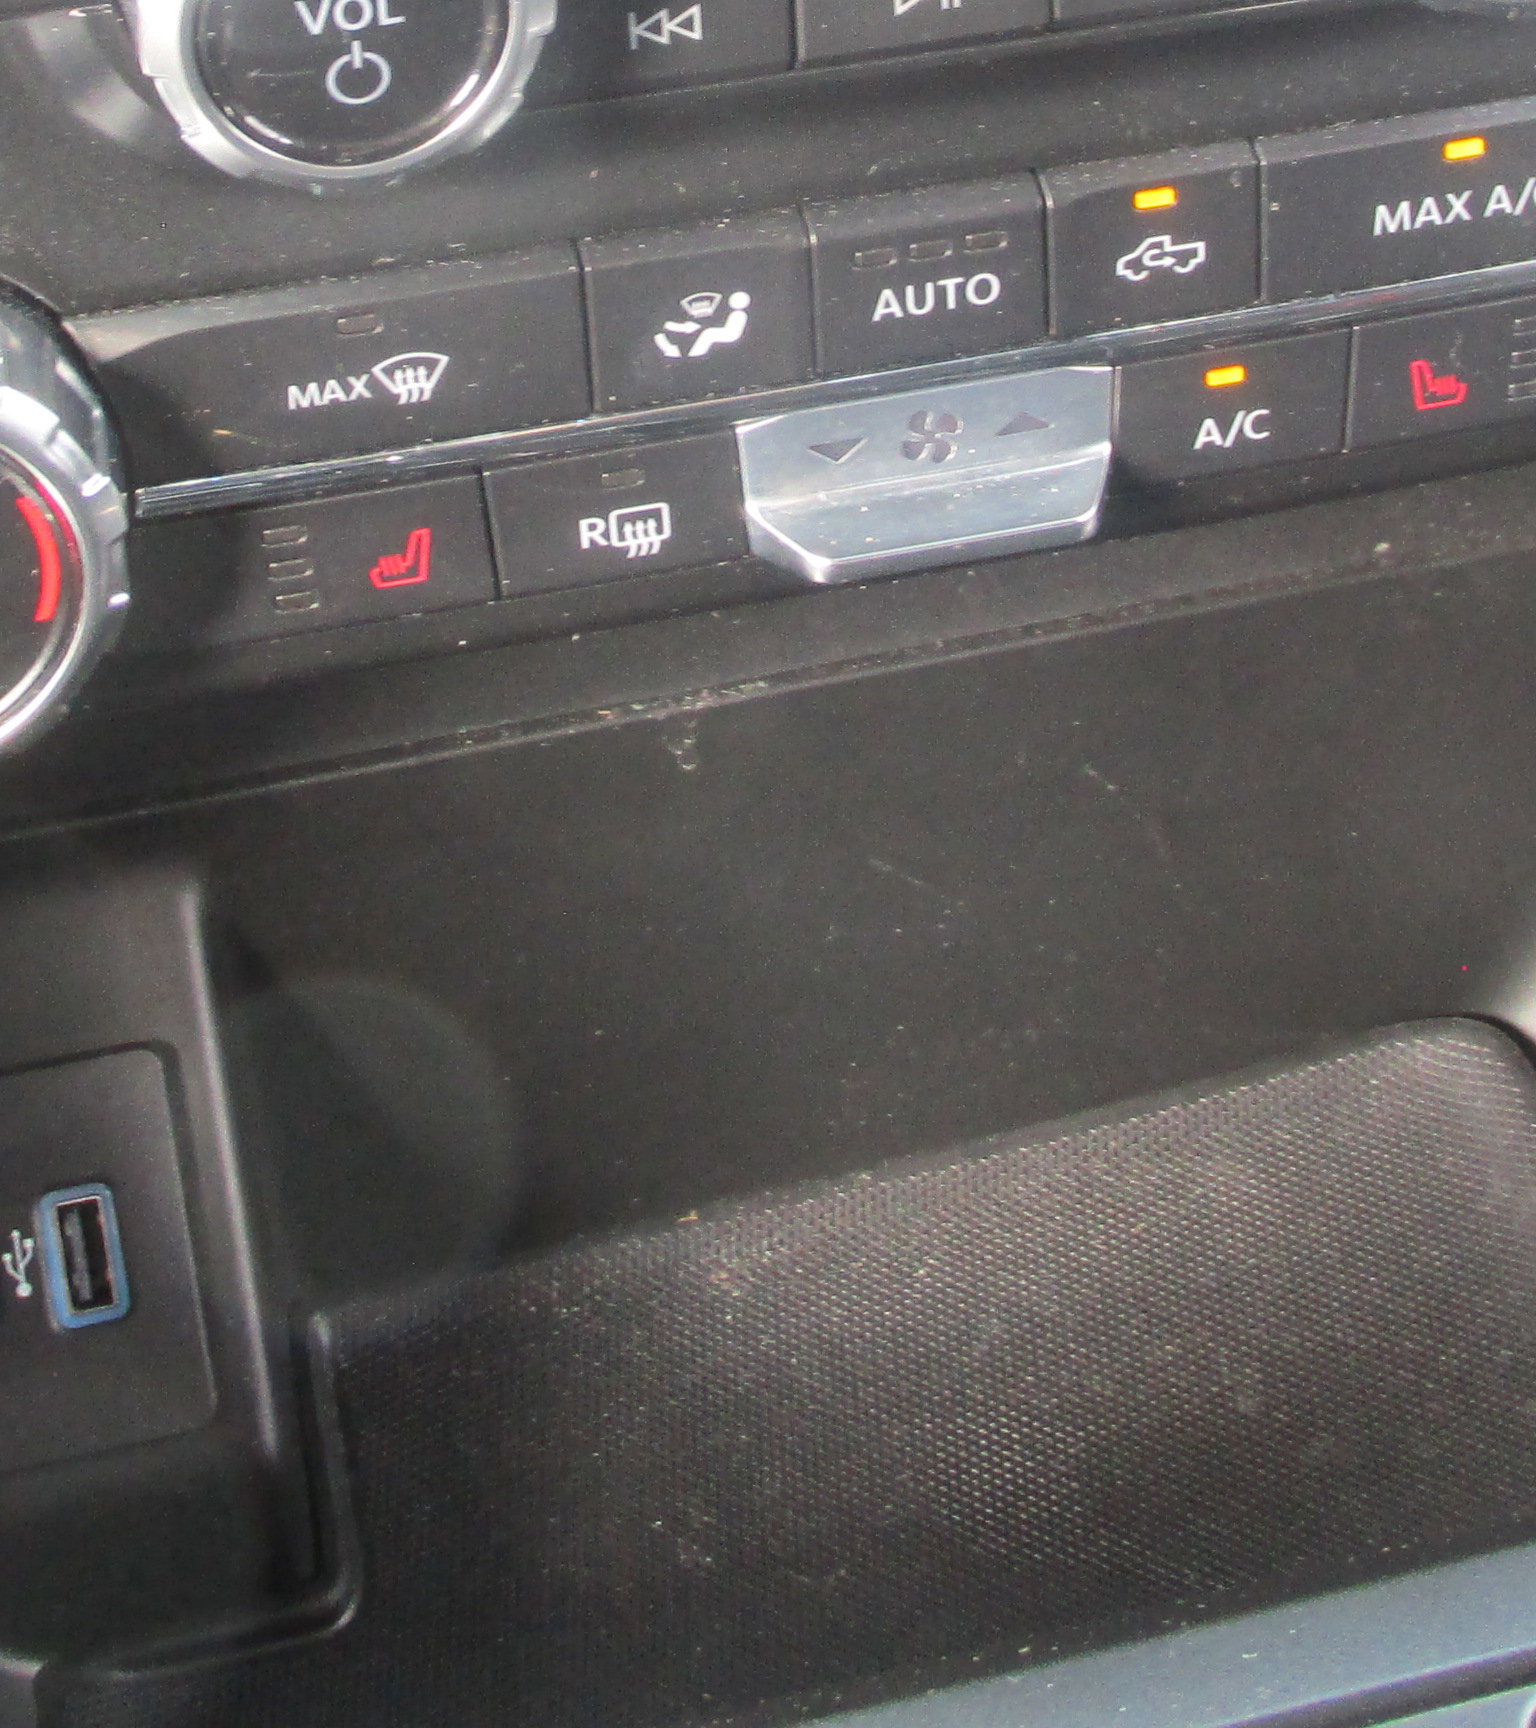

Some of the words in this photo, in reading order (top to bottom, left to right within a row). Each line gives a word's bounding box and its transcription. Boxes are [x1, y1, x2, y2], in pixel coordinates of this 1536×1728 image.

[1372, 189, 1473, 237] MAX
[871, 271, 1003, 323] AUTO
[286, 376, 372, 412] MAX
[1193, 407, 1272, 451] A/C
